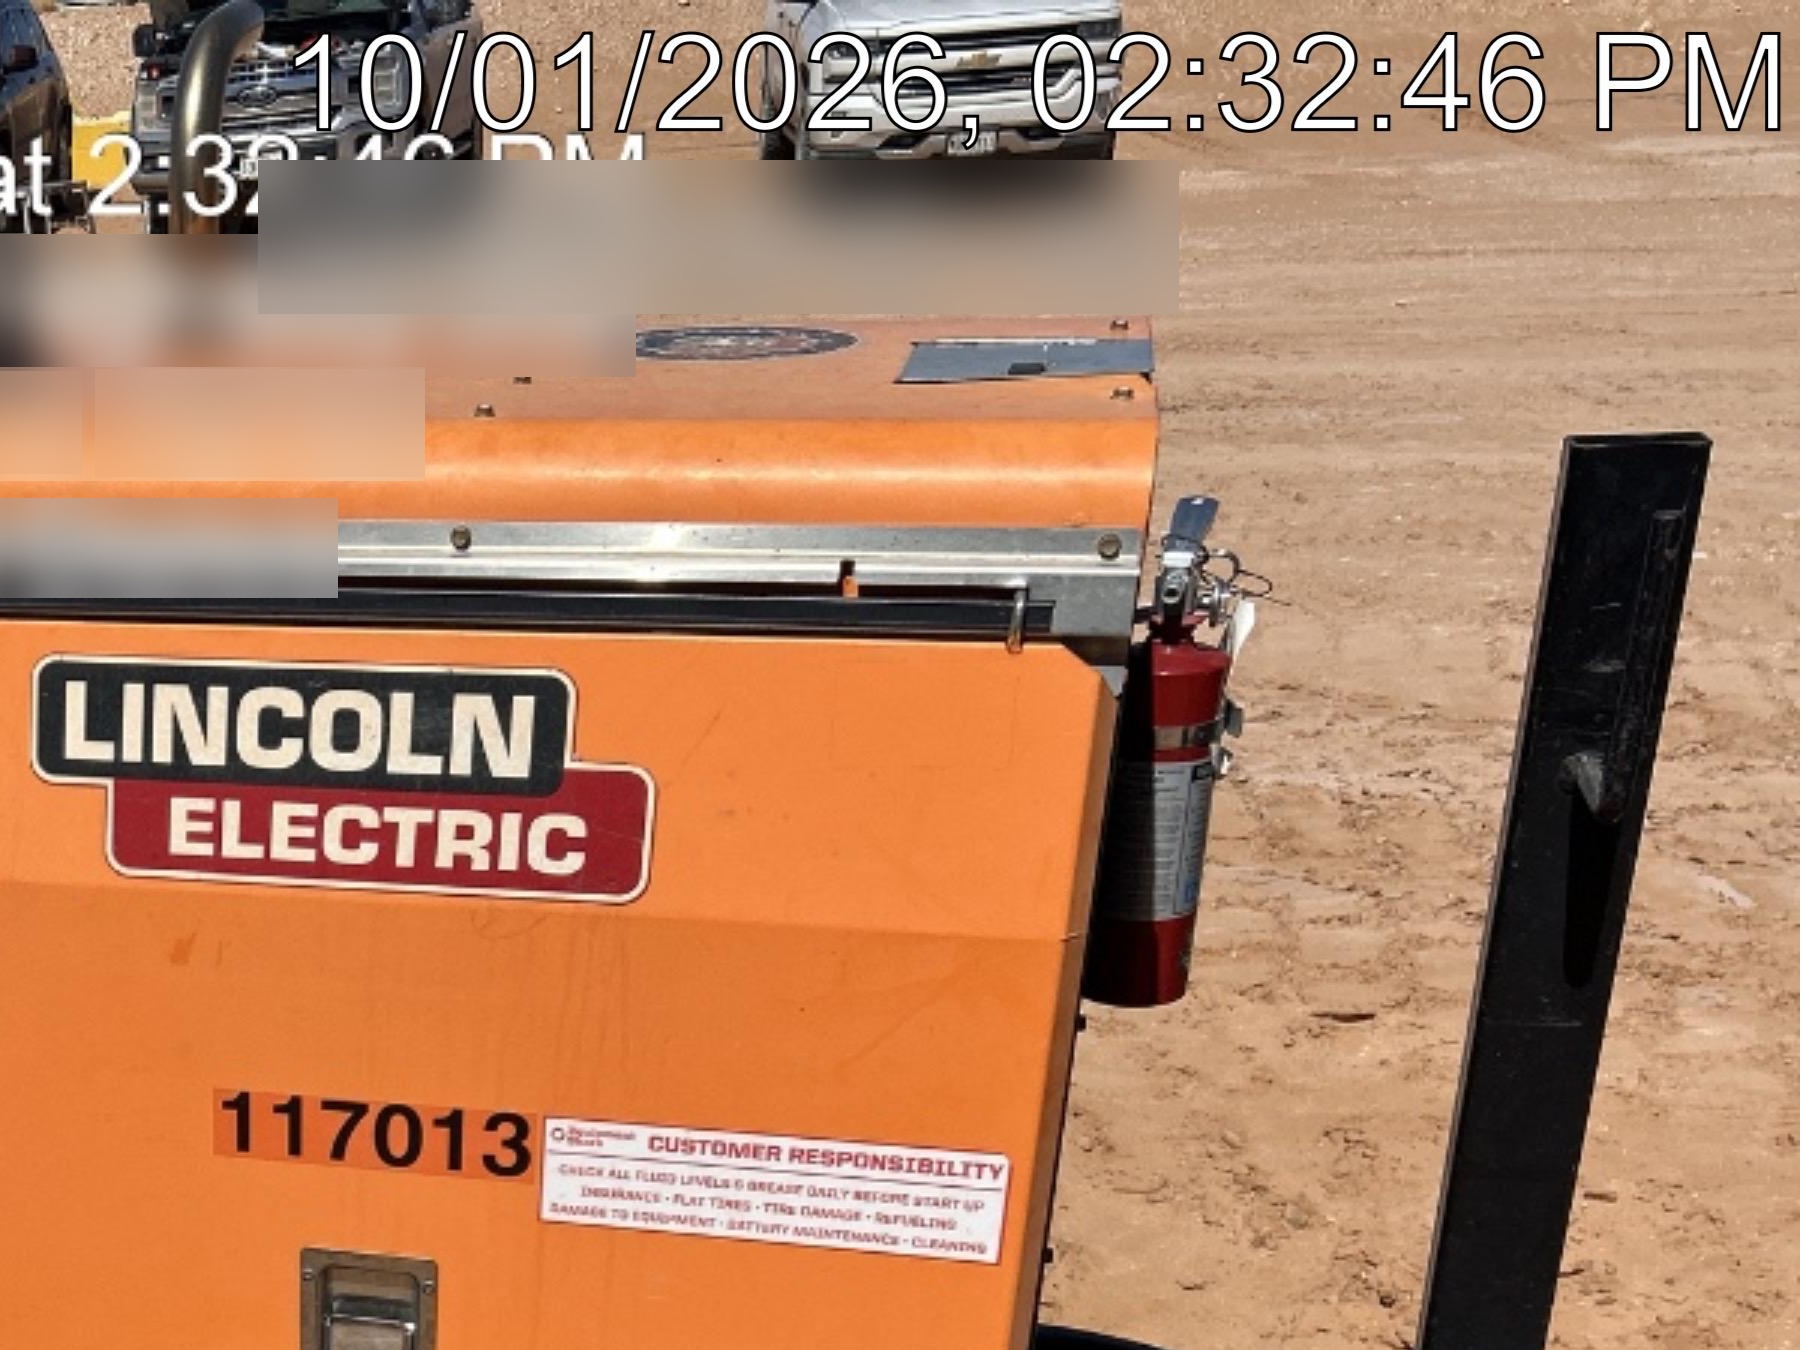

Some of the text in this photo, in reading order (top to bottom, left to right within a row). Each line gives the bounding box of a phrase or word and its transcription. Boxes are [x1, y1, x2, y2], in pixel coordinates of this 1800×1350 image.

[63, 680, 536, 779] LINCOLN
[167, 796, 588, 876] ELECTRIC
[221, 1090, 532, 1177] 117013
[648, 1135, 1004, 1181] CUSTOMER RESPONSIBILITY
[558, 1163, 604, 1178] CHECK
[608, 1167, 631, 1181] ALL
[680, 1173, 730, 1189] LEVELS
[913, 1195, 960, 1211] START
[632, 1209, 717, 1229] EQUIPMENT
[791, 1226, 901, 1247] MAINTENANCE
[911, 1236, 988, 1255] CLEANING
